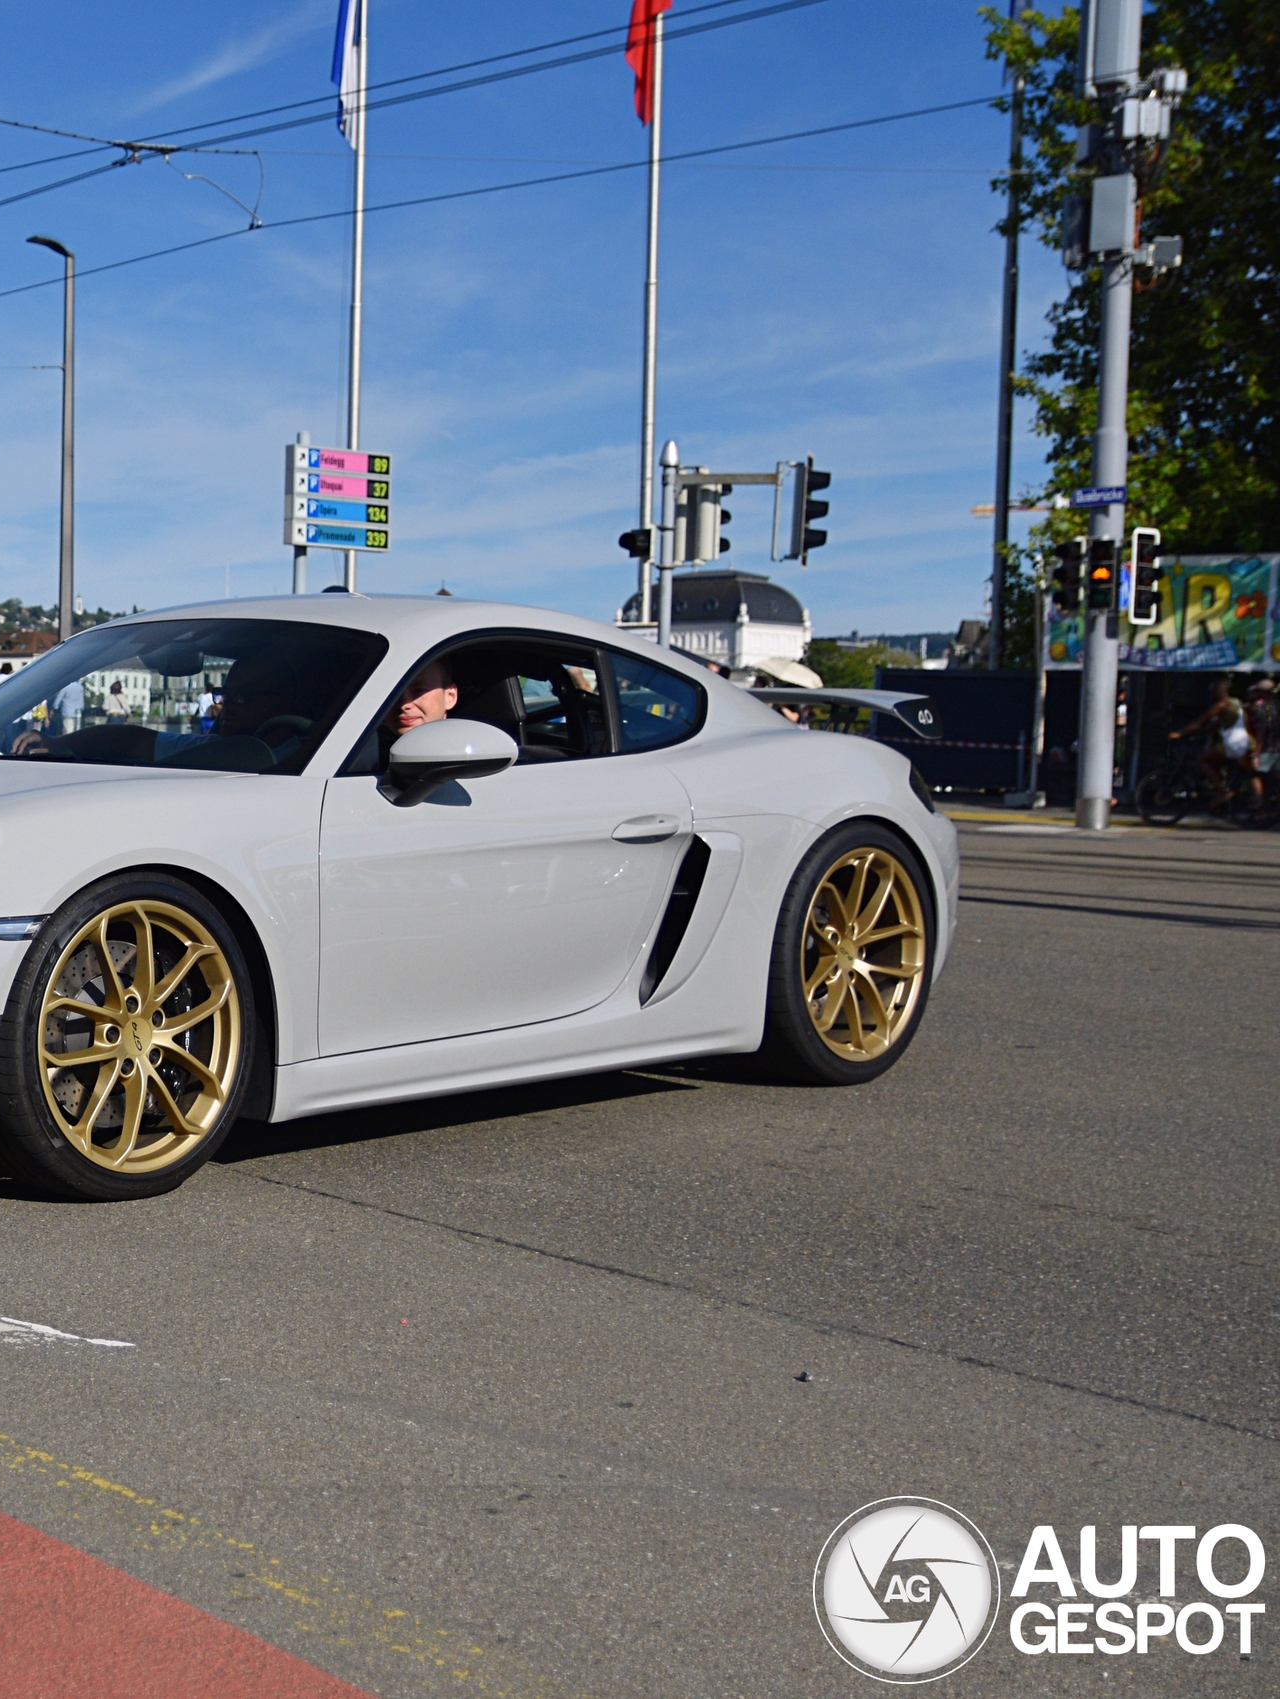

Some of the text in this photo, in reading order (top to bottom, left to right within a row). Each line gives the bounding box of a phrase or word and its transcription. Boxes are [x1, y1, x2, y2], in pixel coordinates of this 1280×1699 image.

[373, 482, 387, 497] 37
[368, 507, 386, 522] 134
[319, 529, 355, 542] Promenade
[367, 531, 386, 546] 339
[132, 1022, 142, 1051] GT4
